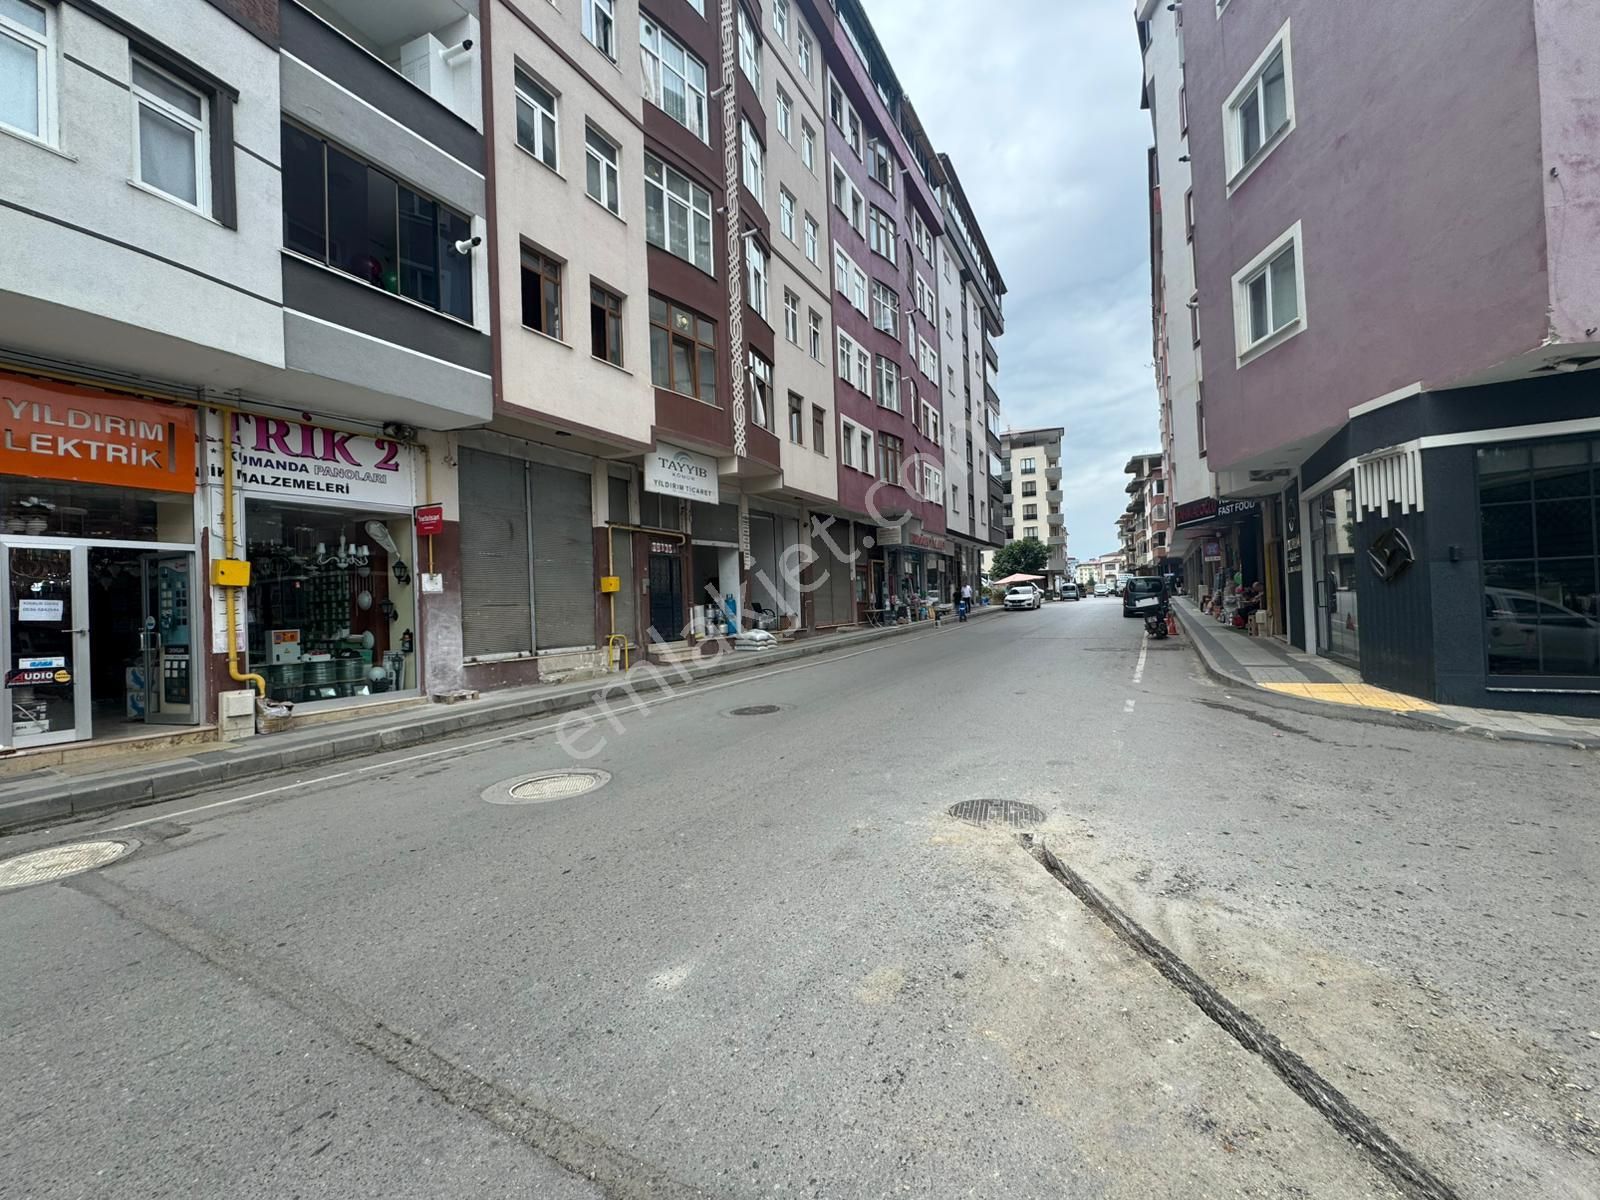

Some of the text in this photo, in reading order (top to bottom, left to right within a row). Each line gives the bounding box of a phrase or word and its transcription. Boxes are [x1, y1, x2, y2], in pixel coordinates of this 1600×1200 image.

[2, 396, 164, 442] YILDIRIM
[4, 428, 163, 470] LEKTRİK
[374, 438, 400, 472] 2
[231, 449, 388, 485] KUMANDA PANOLARI
[236, 469, 351, 495] MALZEMELERİ
[1217, 504, 1235, 516] FAST
[1234, 500, 1256, 513] FOOD
